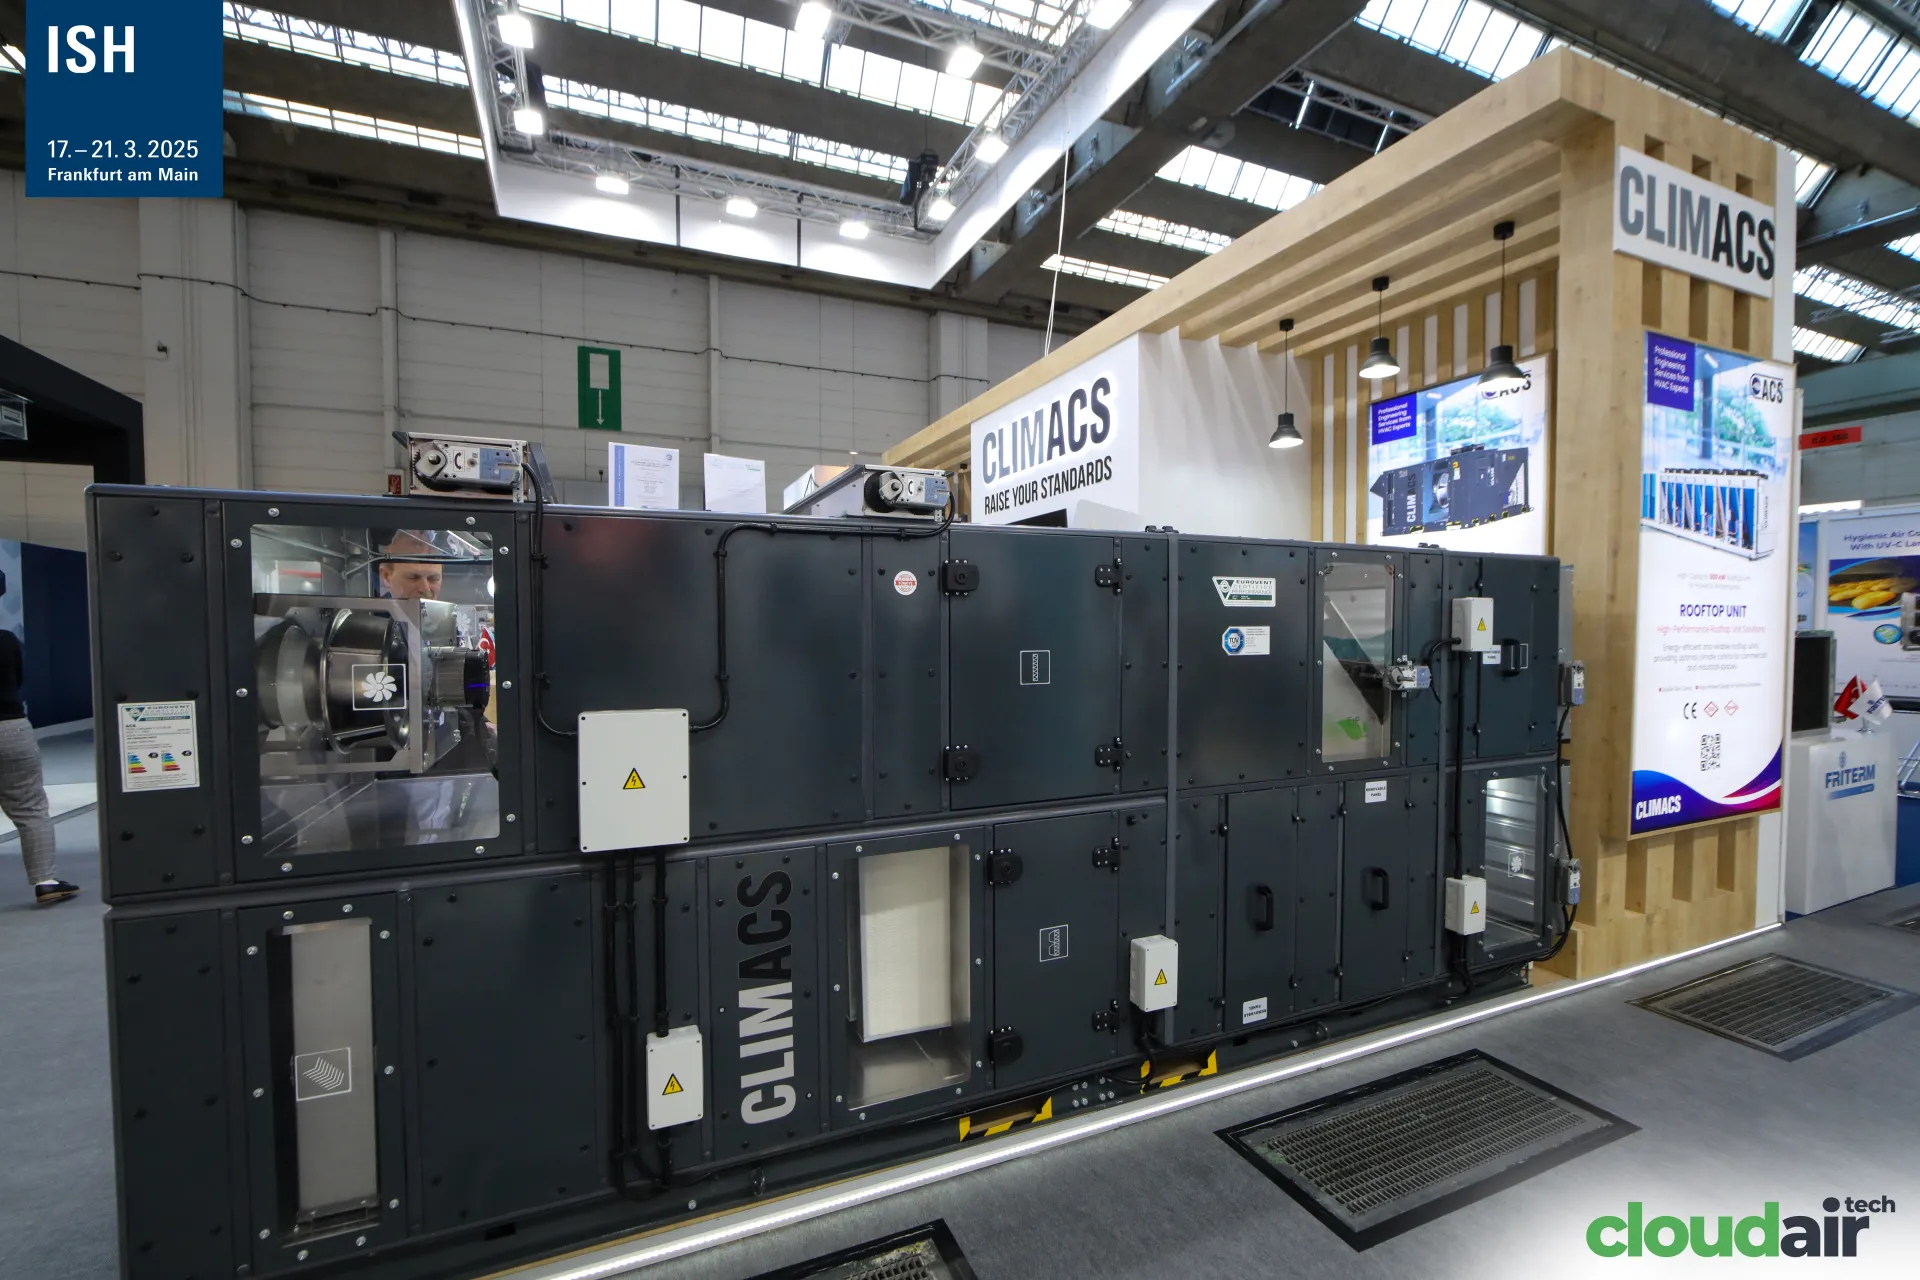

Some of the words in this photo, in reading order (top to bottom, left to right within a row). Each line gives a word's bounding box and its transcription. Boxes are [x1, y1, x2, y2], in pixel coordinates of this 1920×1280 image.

[1620, 165, 1775, 280] CLIMACS
[1762, 381, 1784, 404] ACS
[1377, 402, 1408, 415] Professional
[1377, 410, 1407, 422] Engineering
[982, 377, 1111, 484] CLIMACS
[1377, 418, 1399, 428] Services
[1393, 421, 1411, 431] Experts
[985, 489, 1010, 515] RAISE
[1012, 480, 1038, 507] YOUR
[1041, 455, 1112, 499] STANDARDS
[1407, 473, 1416, 523] CLIMACS
[1844, 532, 1888, 543] Hygienic
[1850, 543, 1874, 551] With
[1876, 540, 1903, 549] UV-C
[1680, 604, 1724, 617] ROOFTOP
[1727, 605, 1747, 617] UNIT
[1825, 764, 1876, 789] FRITERM
[1635, 795, 1682, 820] CLIMACS
[737, 871, 797, 1125] CLIMACS
